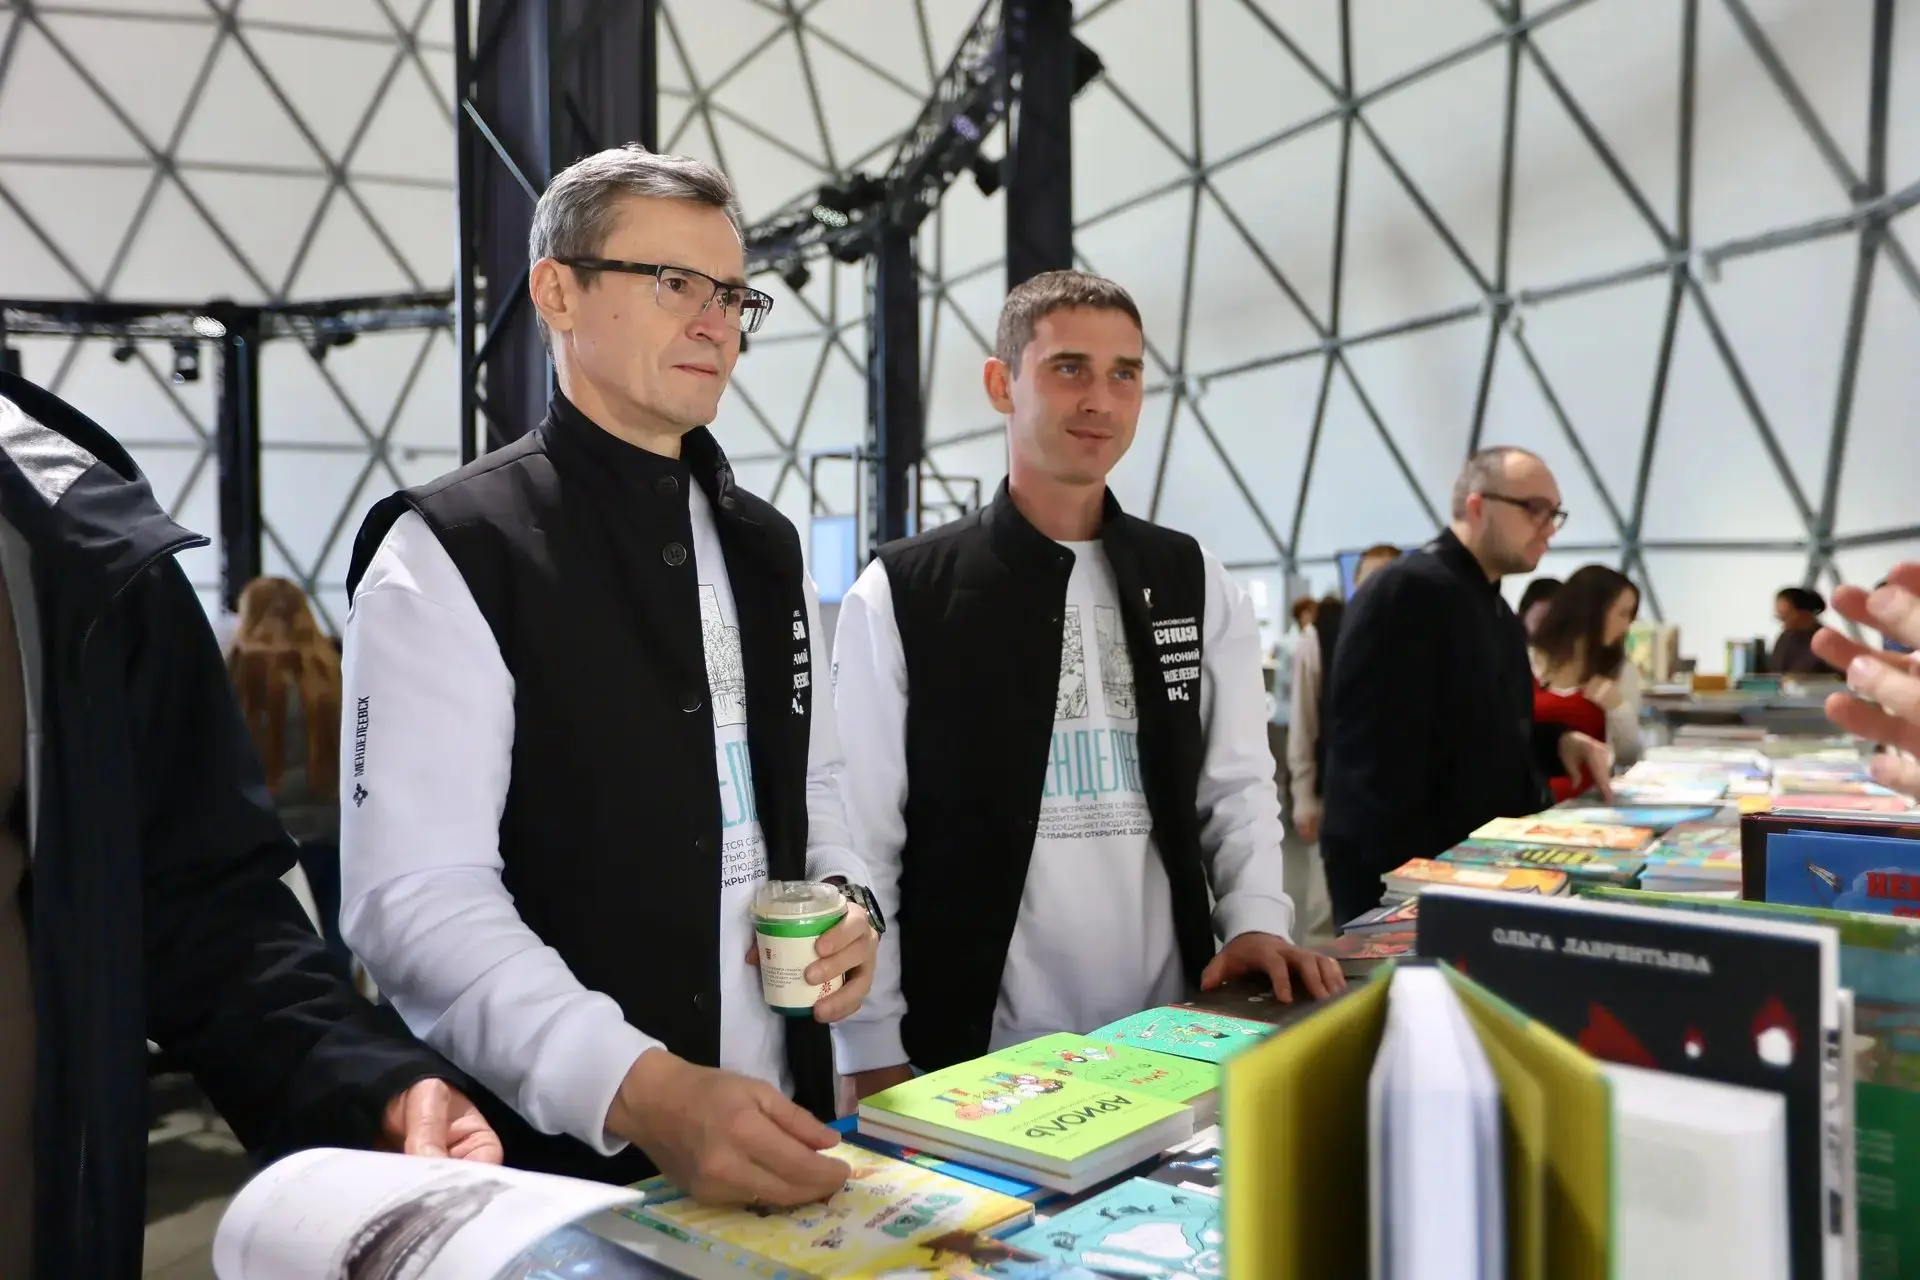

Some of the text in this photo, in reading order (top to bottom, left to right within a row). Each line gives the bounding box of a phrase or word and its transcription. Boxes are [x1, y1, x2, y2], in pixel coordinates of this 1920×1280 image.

[354, 696, 370, 778] МЕНДЕЛЕЕВСК
[1492, 927, 1712, 974] ОЛЬГА ЛАВРЕНТЬЕВА
[1025, 1094, 1133, 1138] АРИОЛЬ
